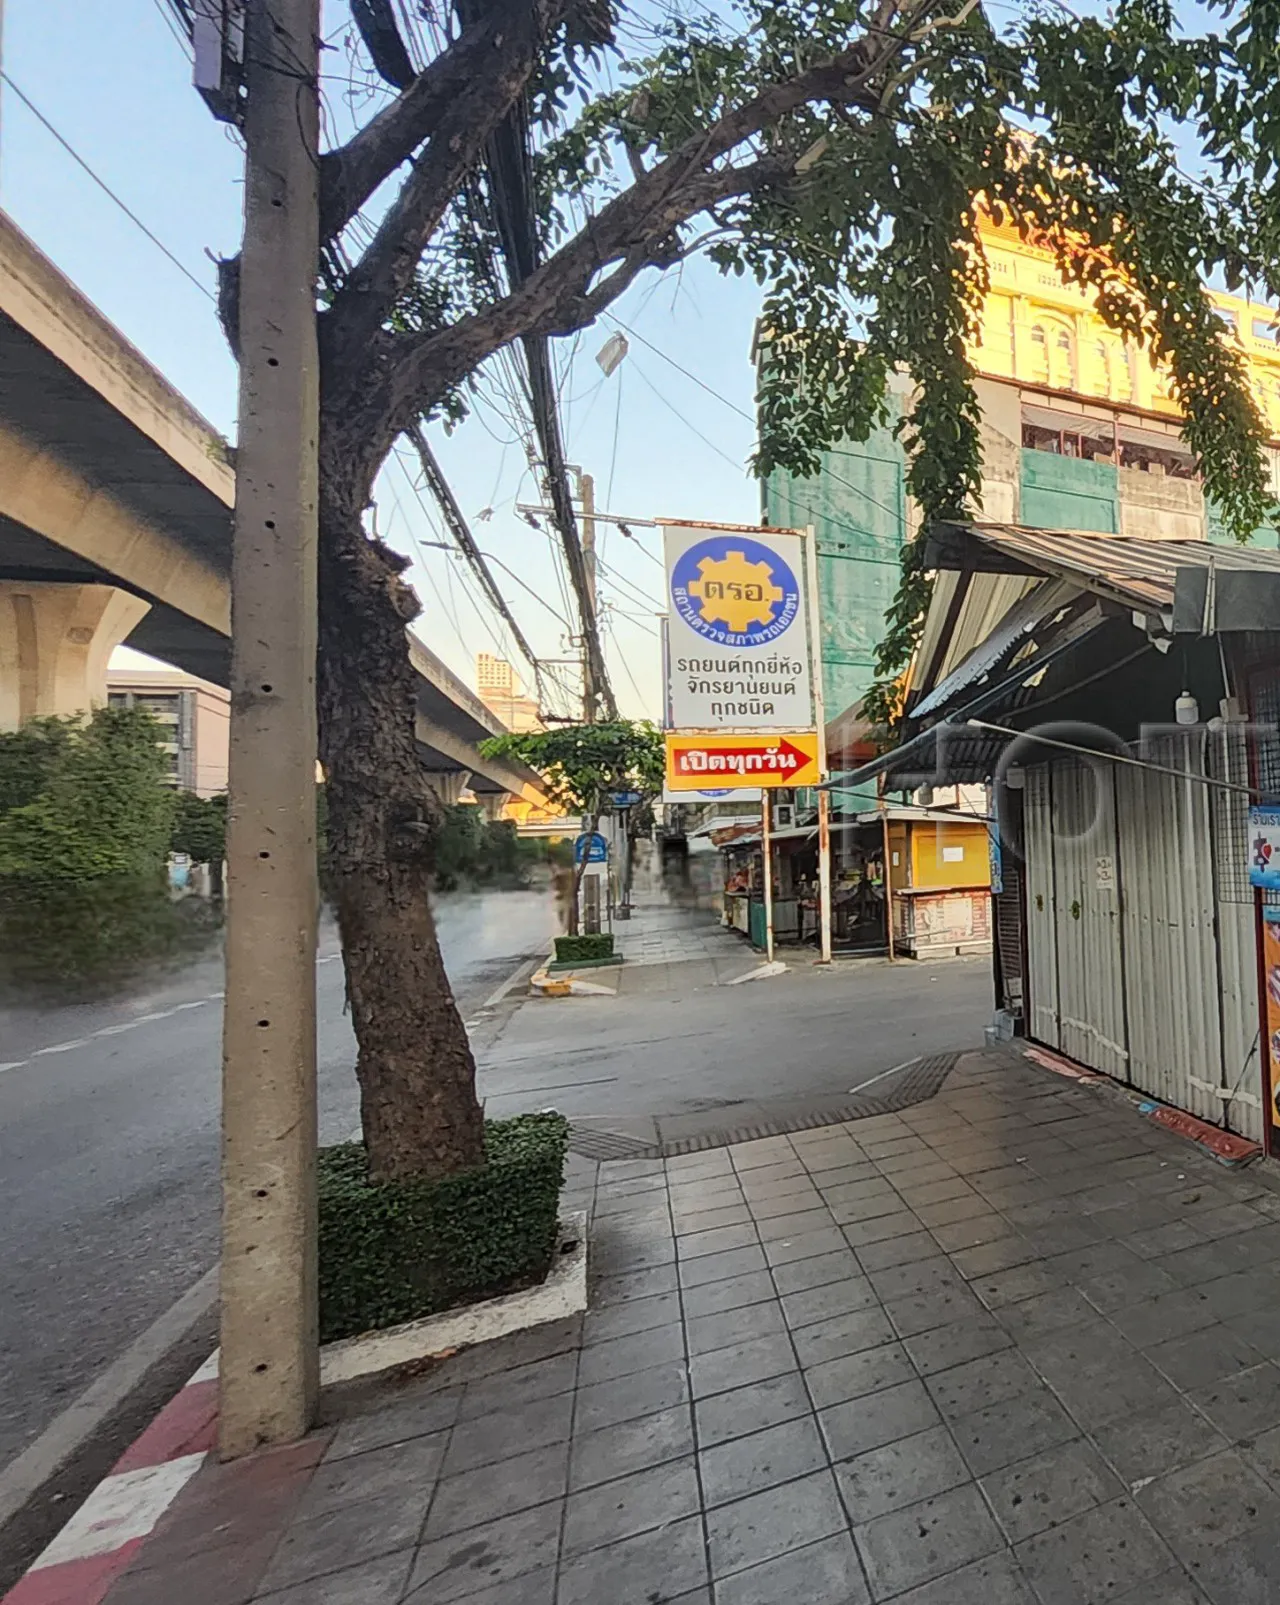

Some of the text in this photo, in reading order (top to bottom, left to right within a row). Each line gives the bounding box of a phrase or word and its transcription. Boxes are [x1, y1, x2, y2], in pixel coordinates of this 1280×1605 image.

[677, 653, 803, 680] รถยนต์ทุกยี่ห้อ
[687, 676, 796, 696] จักรยานยนต์
[711, 699, 775, 721] ทุกชนิด
[680, 747, 797, 775] เปิดทุกวัน
